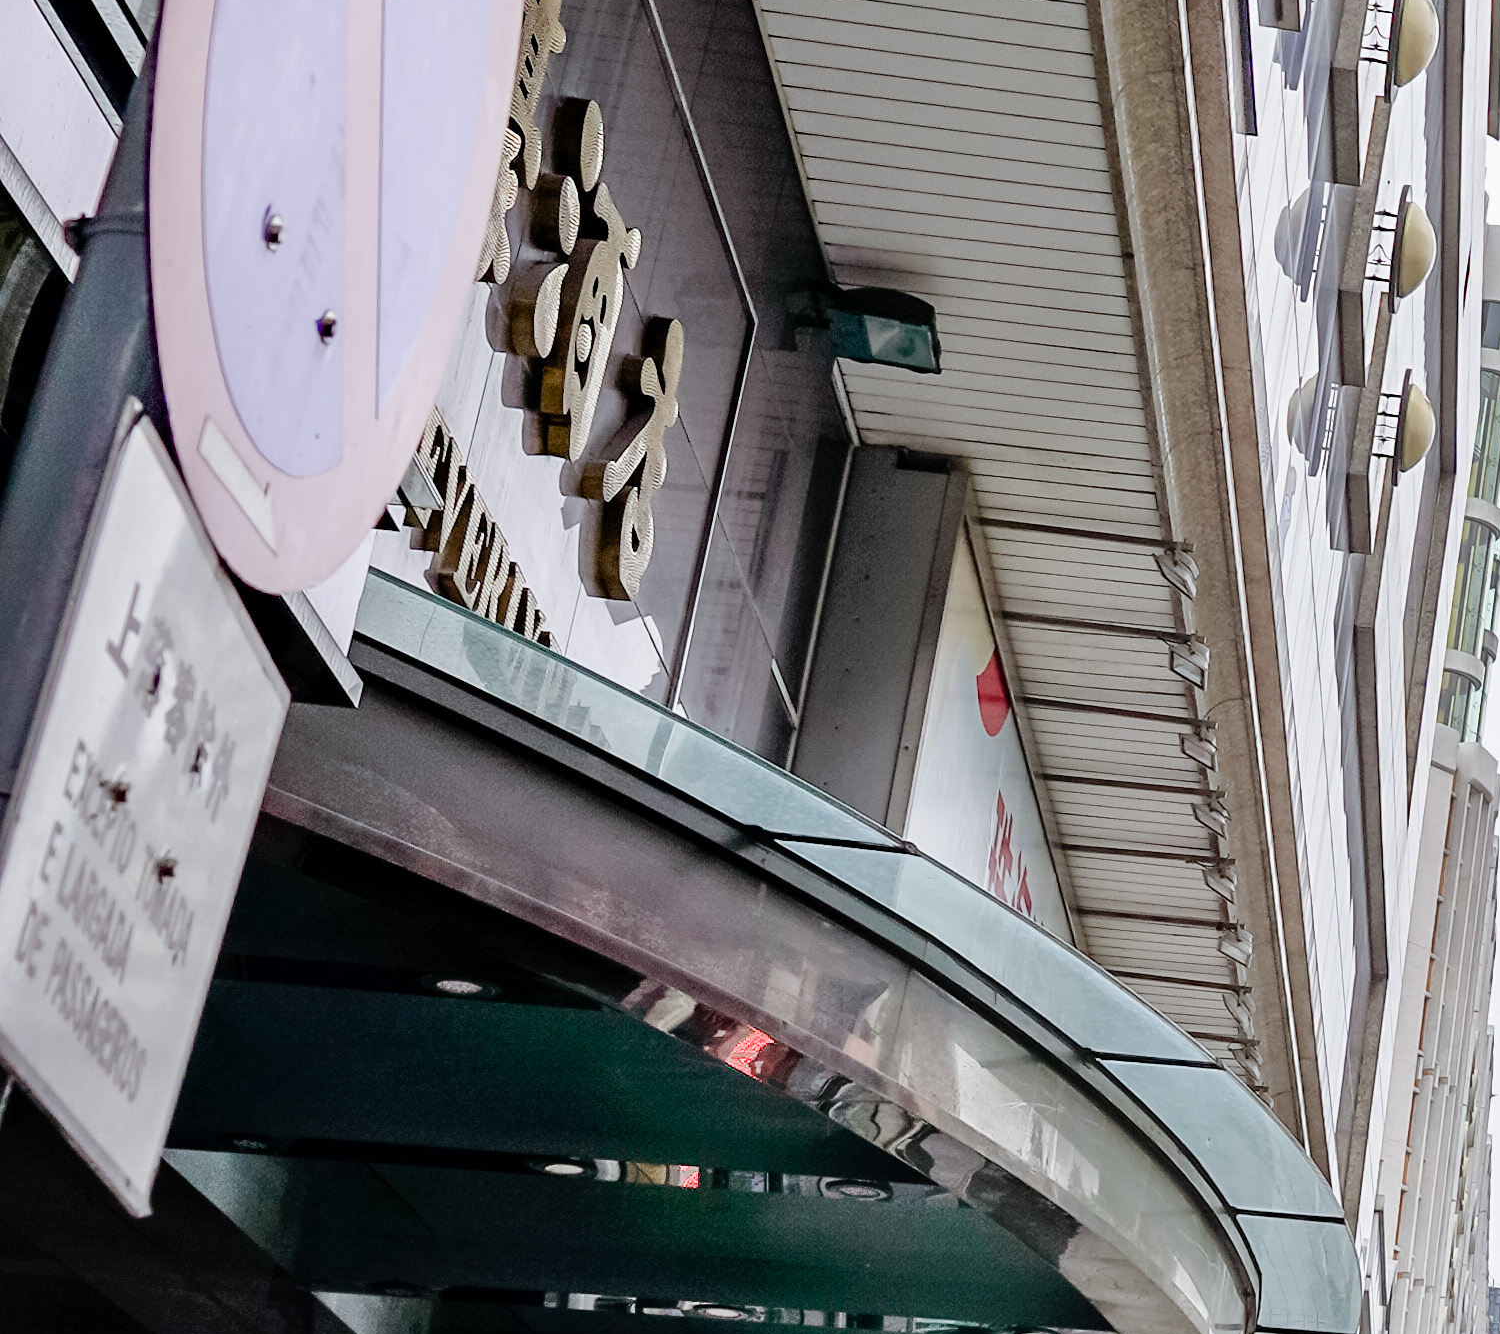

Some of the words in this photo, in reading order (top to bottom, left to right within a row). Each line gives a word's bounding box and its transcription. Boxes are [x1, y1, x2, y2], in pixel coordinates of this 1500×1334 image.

[40, 819, 63, 884] E
[54, 857, 135, 987] LARGADA
[63, 738, 137, 874] EXCEPTO
[136, 840, 195, 969] TOMADA
[14, 899, 50, 980] DE
